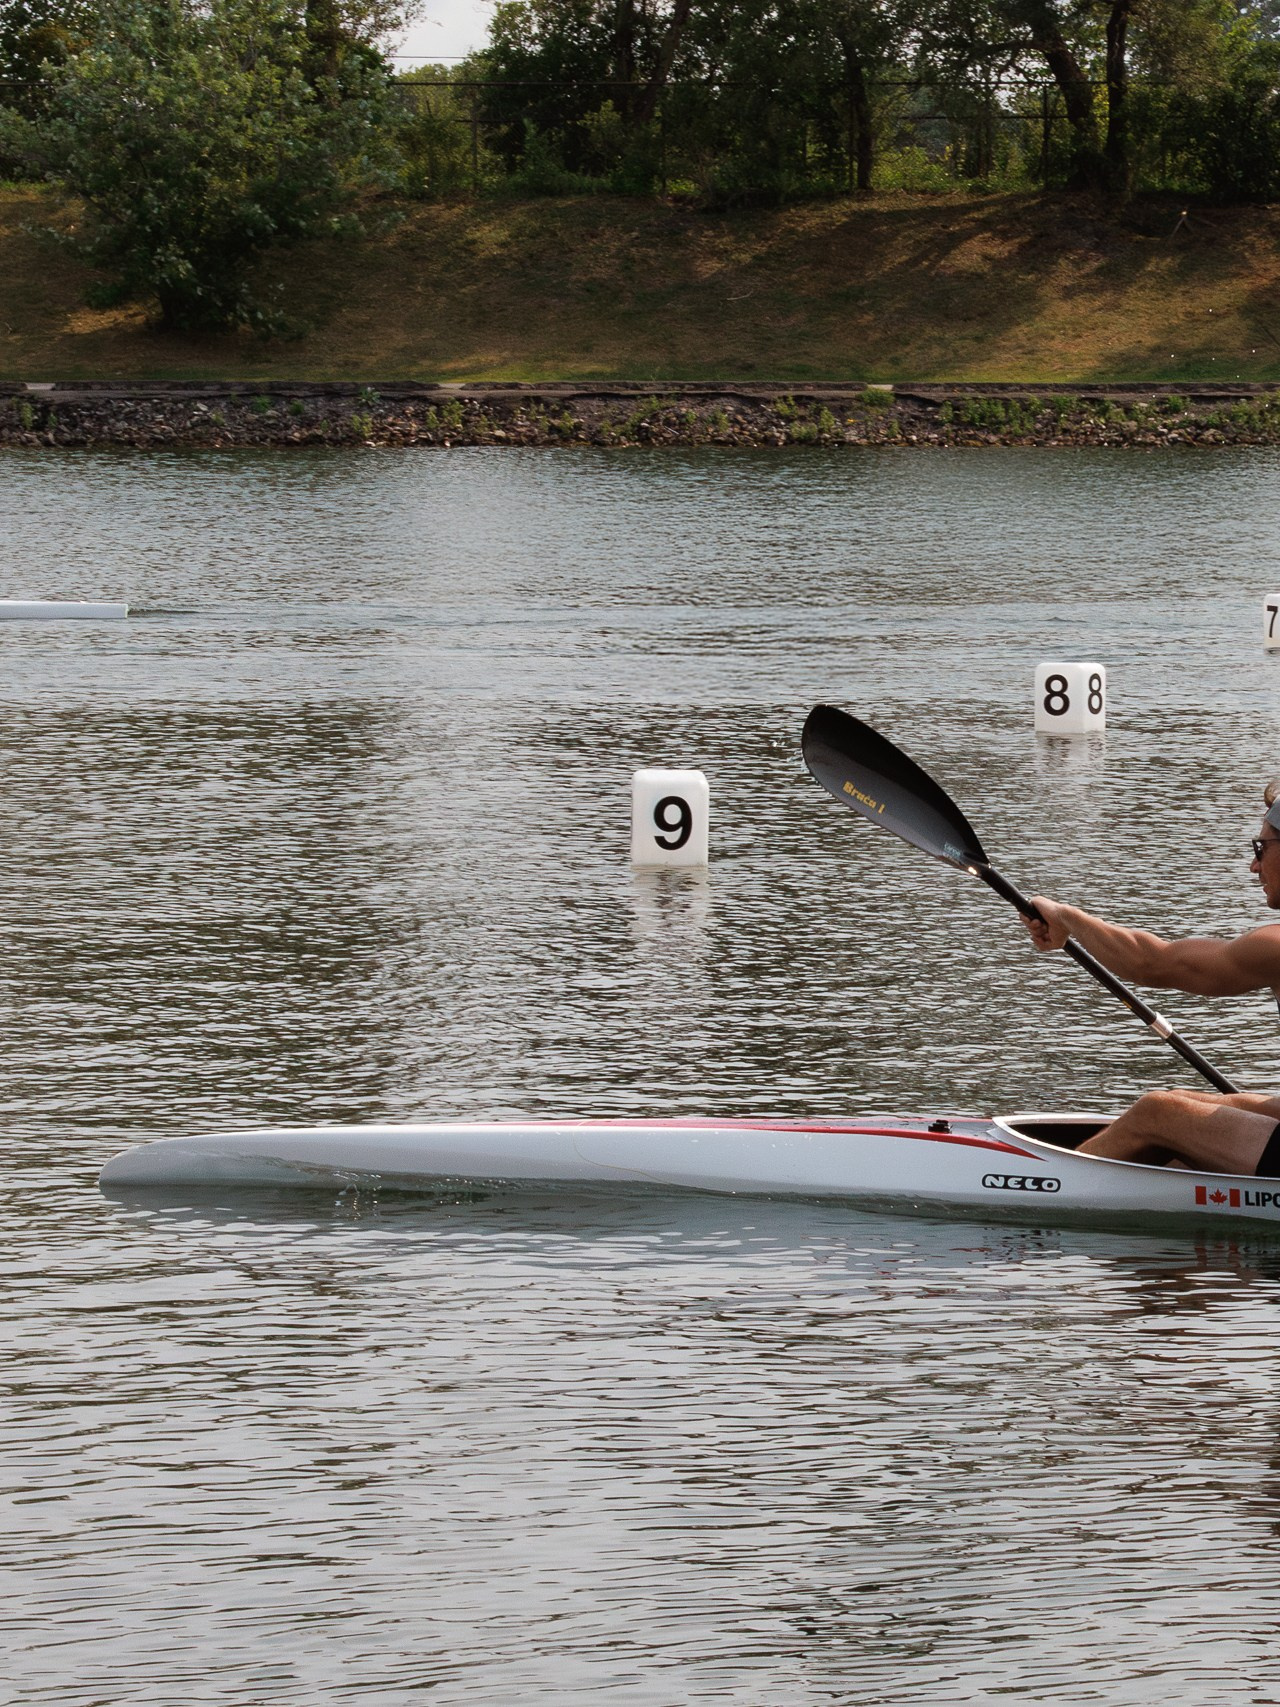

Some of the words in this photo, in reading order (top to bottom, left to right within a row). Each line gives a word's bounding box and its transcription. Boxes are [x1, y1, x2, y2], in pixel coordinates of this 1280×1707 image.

[1266, 605, 1279, 638] 7
[1043, 674, 1070, 717] 8
[1087, 673, 1103, 715] 8
[653, 795, 693, 851] 9
[984, 1175, 1059, 1191] NELO
